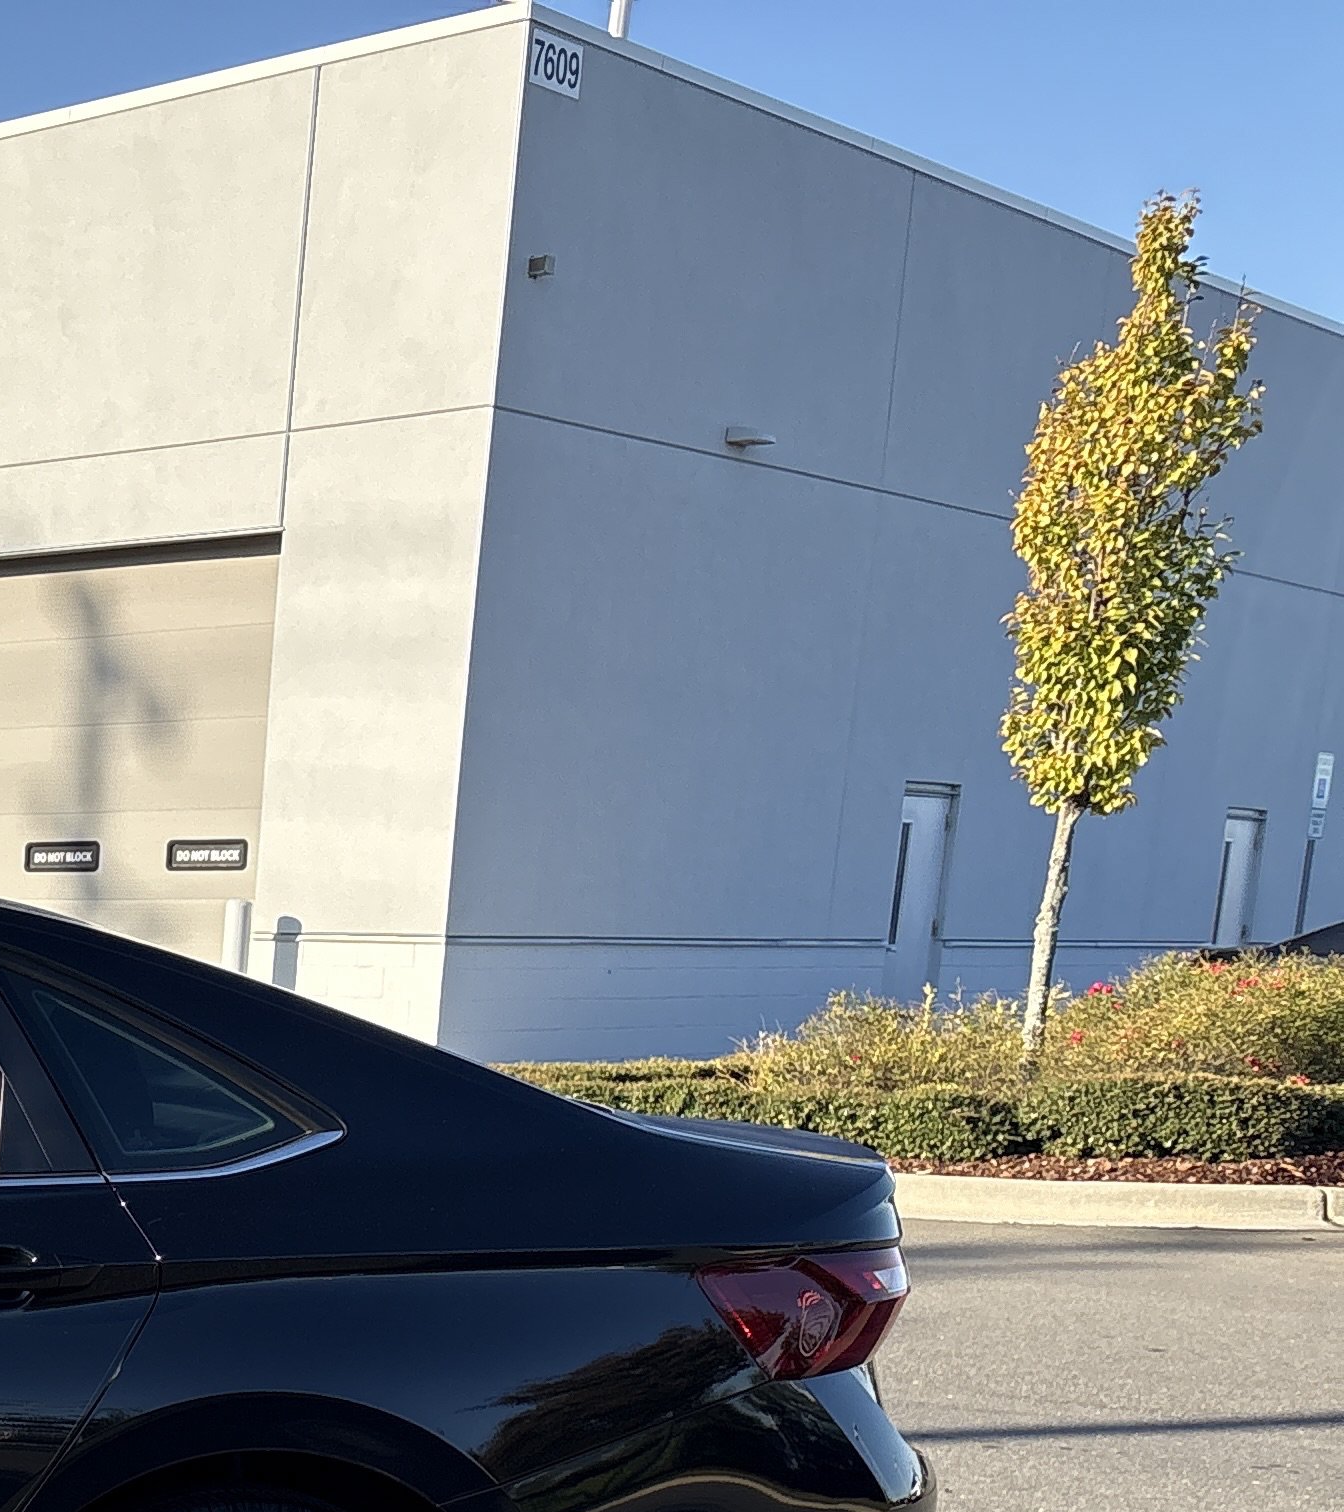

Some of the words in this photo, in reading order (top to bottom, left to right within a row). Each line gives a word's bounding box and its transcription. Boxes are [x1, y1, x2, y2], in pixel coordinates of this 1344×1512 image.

[533, 38, 580, 89] 7609
[34, 852, 46, 863] DO
[47, 851, 65, 863] NOT
[65, 851, 93, 862] BLOCK
[176, 850, 190, 862] DO
[191, 849, 210, 861] NOT
[210, 849, 241, 861] BLOCK
